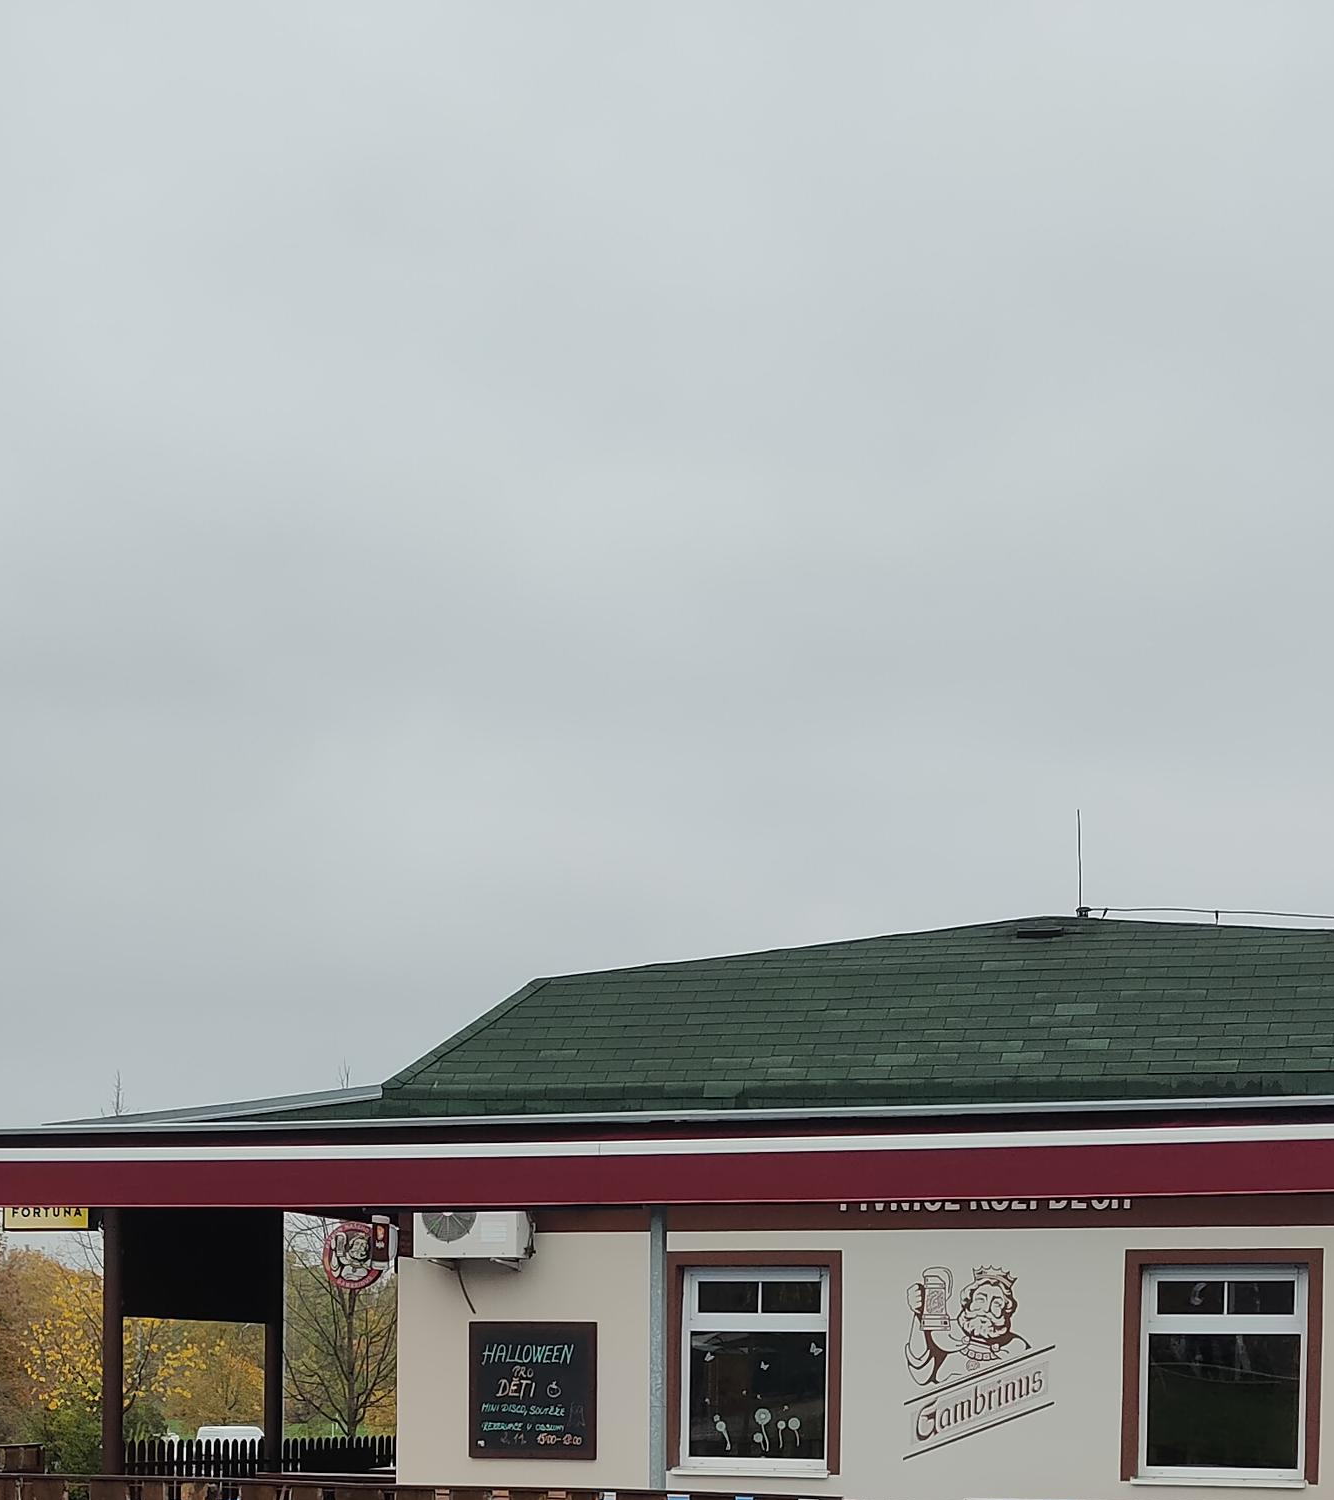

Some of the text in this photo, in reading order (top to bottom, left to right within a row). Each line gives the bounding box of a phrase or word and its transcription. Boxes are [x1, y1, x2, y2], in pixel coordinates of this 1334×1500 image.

[11, 1207, 83, 1217] FORTUNA
[481, 1344, 575, 1366] HALLOWEEN
[512, 1365, 534, 1378] PRO
[496, 1378, 536, 1400] DĚTI
[481, 1403, 500, 1413] MINI
[916, 1370, 1044, 1441] Gambrinus
